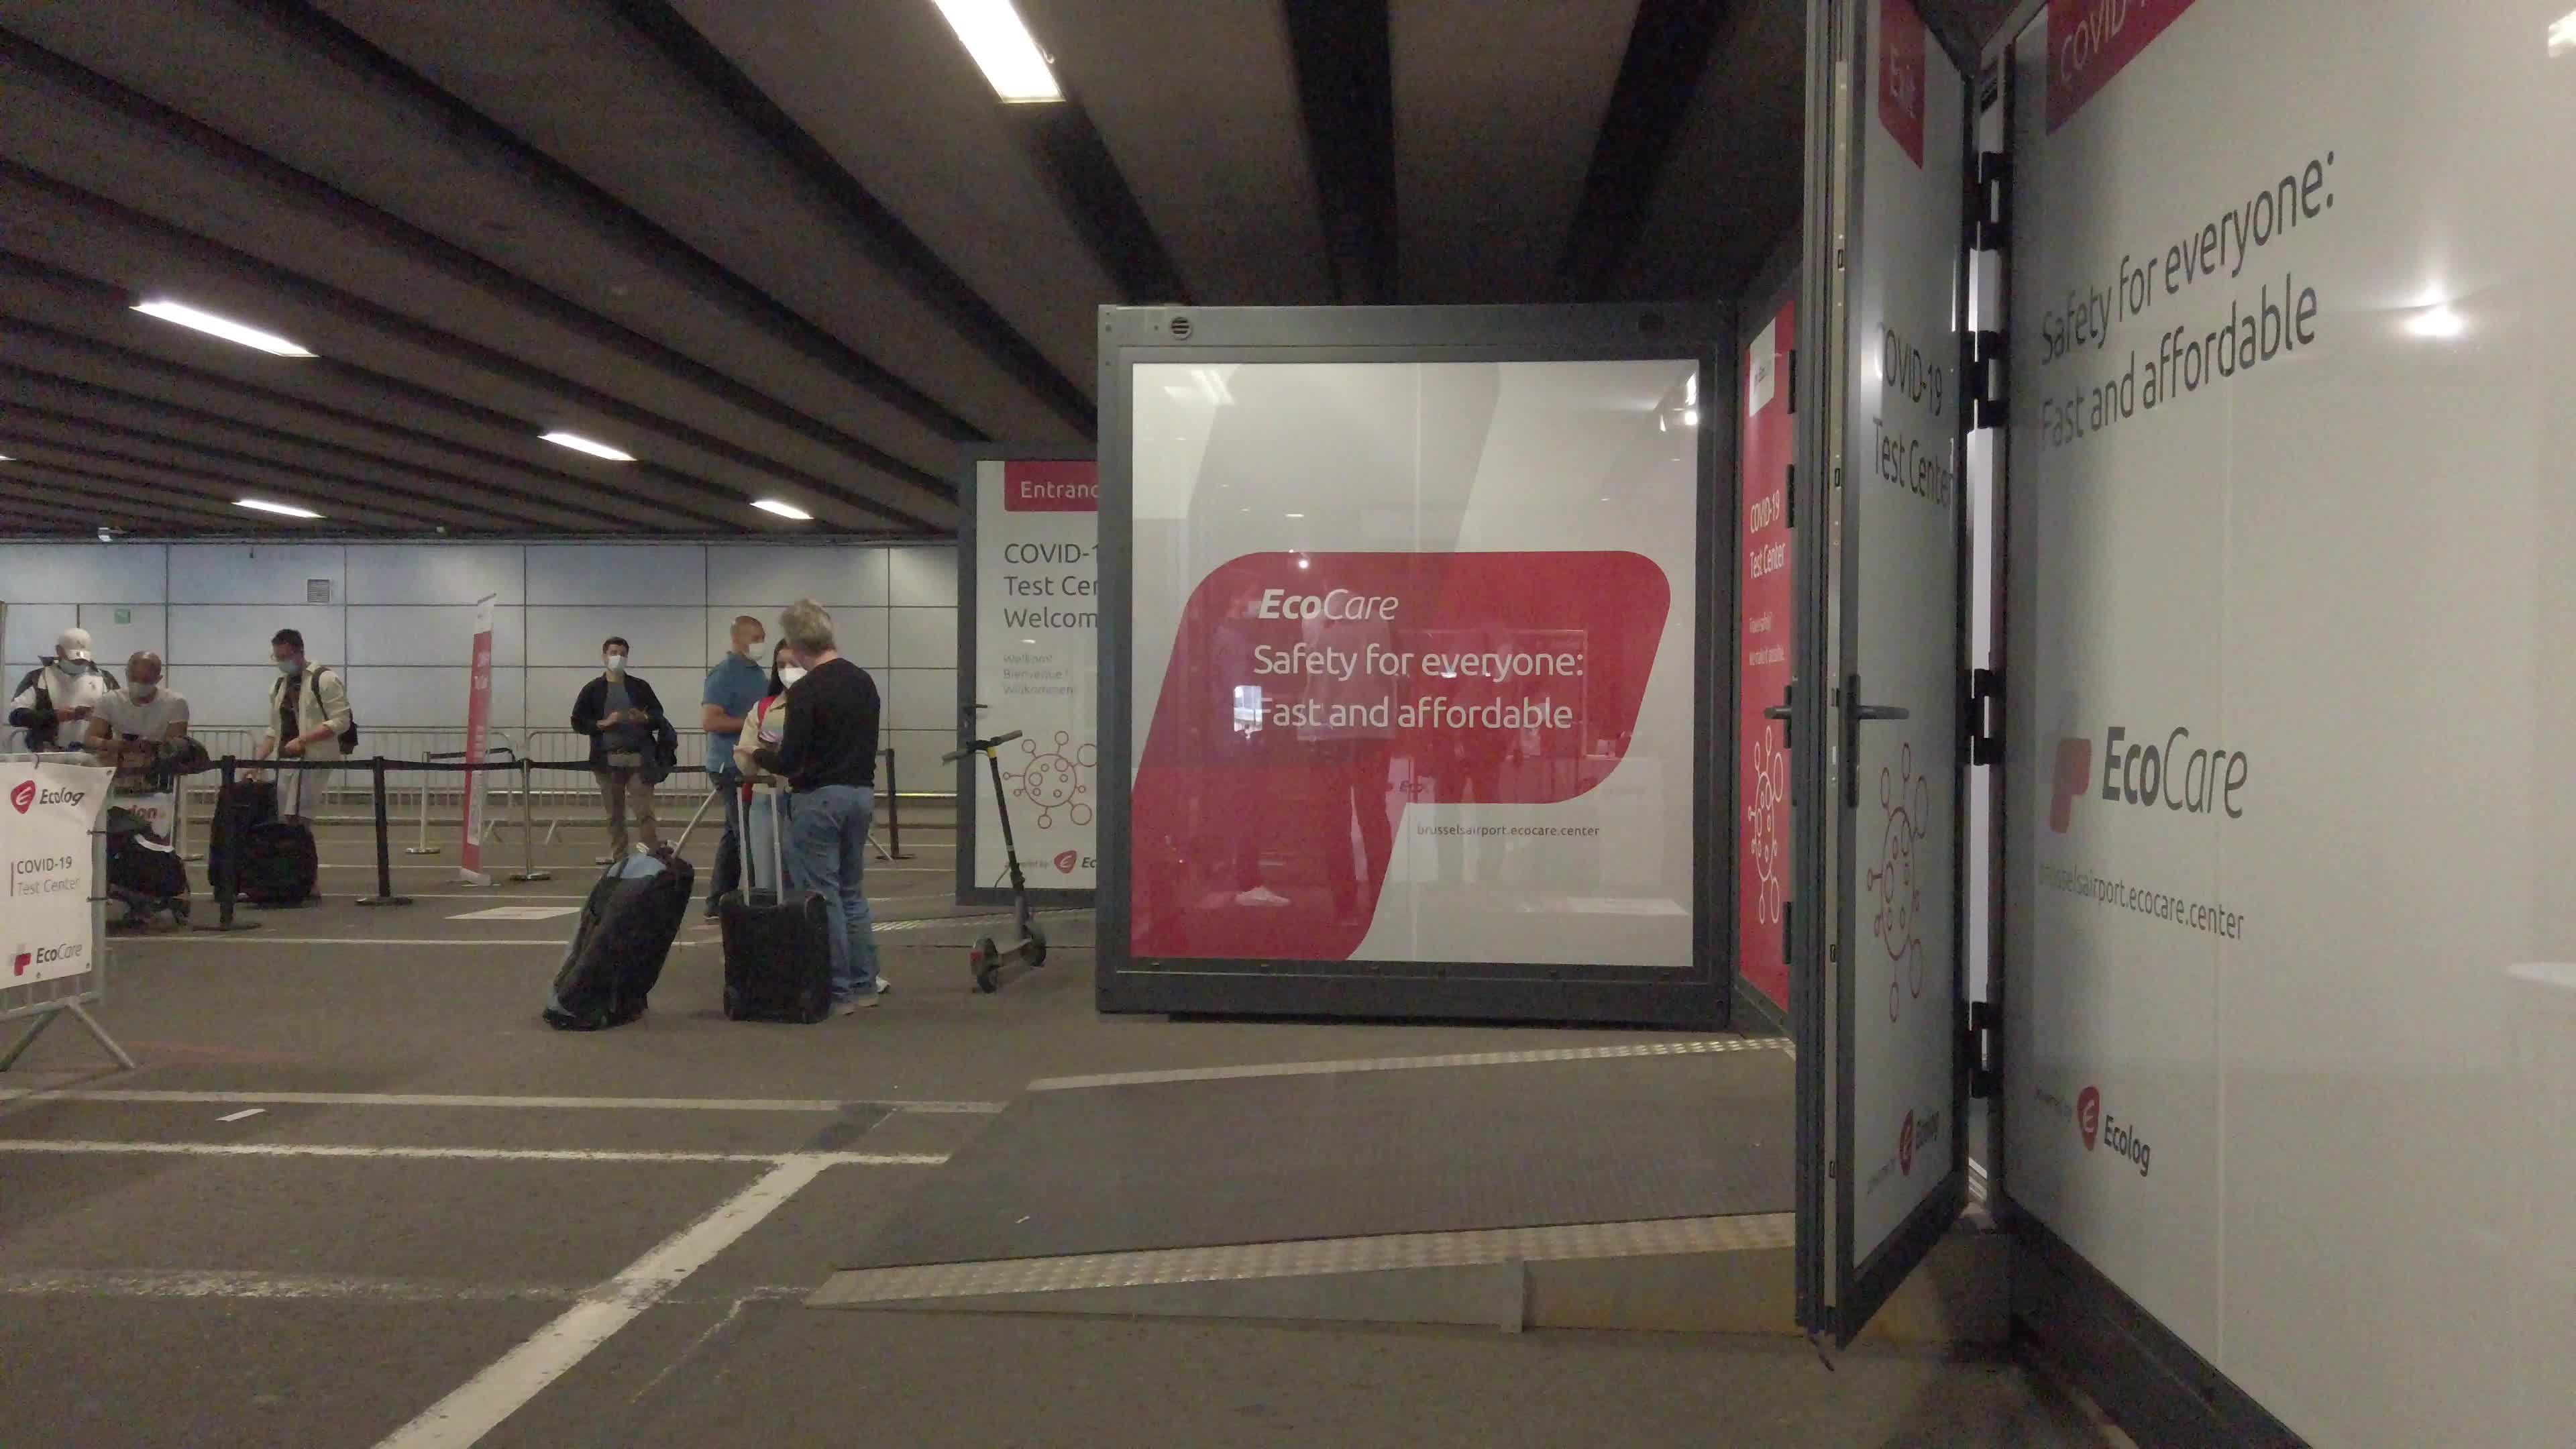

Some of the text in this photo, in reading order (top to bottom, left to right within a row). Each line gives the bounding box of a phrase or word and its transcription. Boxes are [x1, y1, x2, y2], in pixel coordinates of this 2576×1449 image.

[2061, 0, 2145, 85] COVID
[2041, 151, 2334, 365] Safety for everyone:
[1878, 323, 1943, 417] OVID-19
[2041, 272, 2317, 451] Fast and affordable
[1873, 416, 1905, 488] Test
[1750, 490, 1780, 534] COVID-19
[1750, 542, 1786, 579] Test Center
[1004, 576, 1054, 596] Test
[1258, 589, 1399, 620] EcoCare
[1254, 643, 1584, 682] Safety for everyone:
[1262, 696, 1573, 729] Fast and affordable
[2102, 726, 2249, 818] EcoCare
[39, 788, 85, 806] Ecolog
[1417, 824, 1600, 837] brusselsairport.ecocare.center
[17, 856, 72, 874] COVID-19
[17, 877, 80, 896] Test Center
[36, 943, 83, 963] EcoCare
[2104, 1114, 2151, 1177] Ecolog
